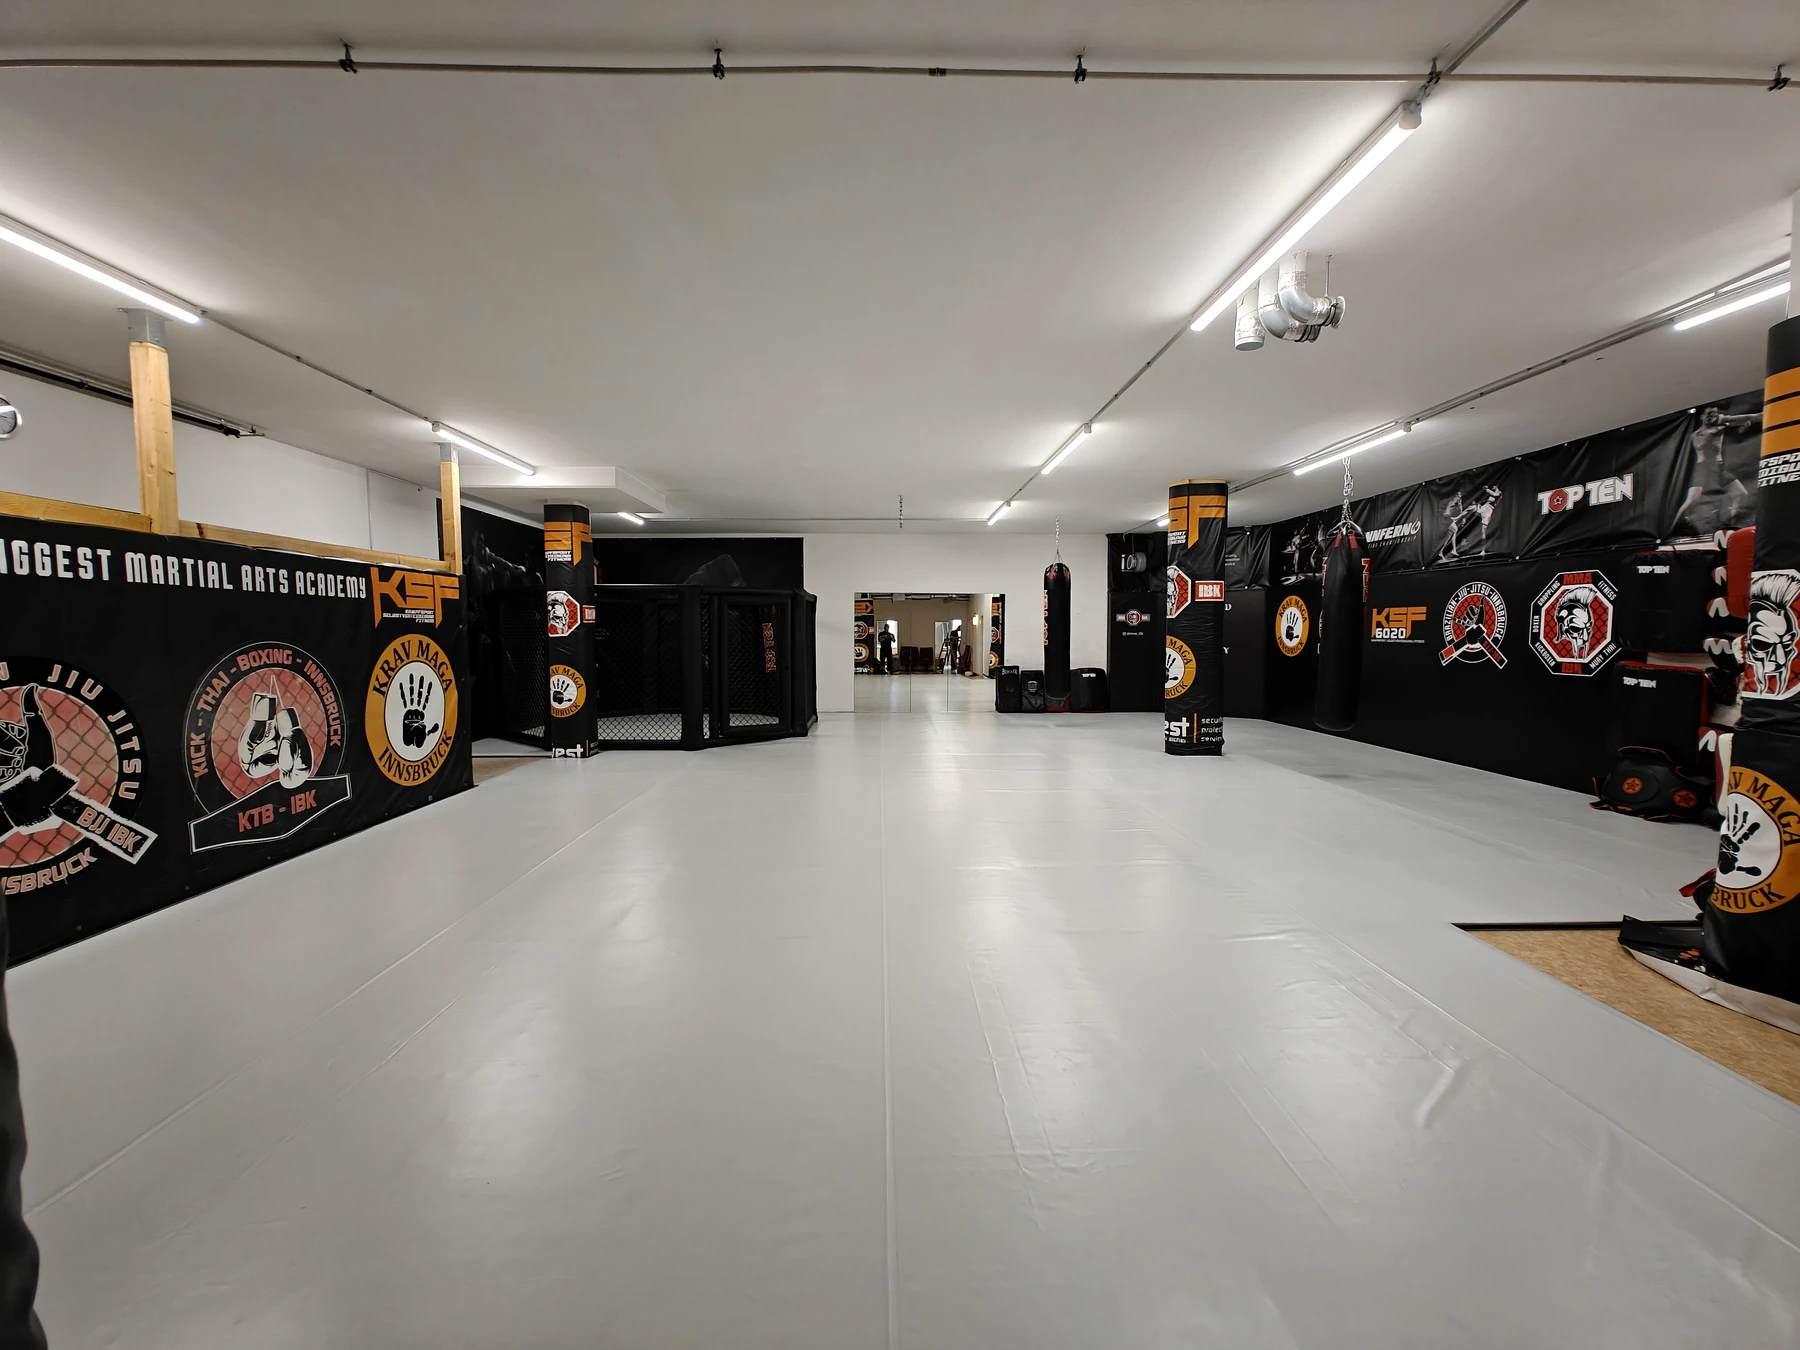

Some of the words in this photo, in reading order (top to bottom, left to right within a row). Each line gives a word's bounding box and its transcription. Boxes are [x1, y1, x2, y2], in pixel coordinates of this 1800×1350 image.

[1537, 484, 1585, 515] TOP
[1585, 473, 1634, 507] TEN
[125, 552, 234, 590] MARTIAL
[241, 564, 289, 594] ARTS
[295, 570, 367, 599] ACADEMY
[1563, 573, 1592, 585] MMA
[1637, 565, 1653, 574] TOP
[1653, 565, 1670, 574] TEN
[370, 567, 460, 629] KSF
[1199, 584, 1222, 598] IBK
[1537, 580, 1561, 606] GRAPPLING
[1597, 580, 1617, 601] FITNESS
[1371, 606, 1427, 639] KSF
[1375, 628, 1406, 639] 6020
[1532, 615, 1540, 633] BOXEN
[236, 649, 293, 672] BOXING
[1169, 638, 1193, 665] MAGA
[1534, 642, 1556, 667] KICKBOXEN
[1589, 653, 1605, 669] MUAY
[1603, 642, 1617, 657] THAI
[372, 639, 412, 698] KRAV
[416, 639, 453, 693] MAGA
[562, 667, 584, 689] MAGA
[1561, 663, 1582, 673] IBK
[196, 670, 231, 713] THAI
[1623, 676, 1638, 686] TOP
[1638, 679, 1656, 688] TEN
[303, 659, 342, 748] INNSBRUCK
[47, 664, 103, 700] JIU
[107, 709, 142, 800] JITSU
[190, 732, 209, 778] KICK
[378, 729, 452, 781] INNSBRUCK
[237, 803, 275, 833] KTB
[290, 789, 318, 815] IBK
[1746, 775, 1800, 848] MAGA
[77, 806, 107, 835] BJJ
[106, 822, 142, 853] IBK
